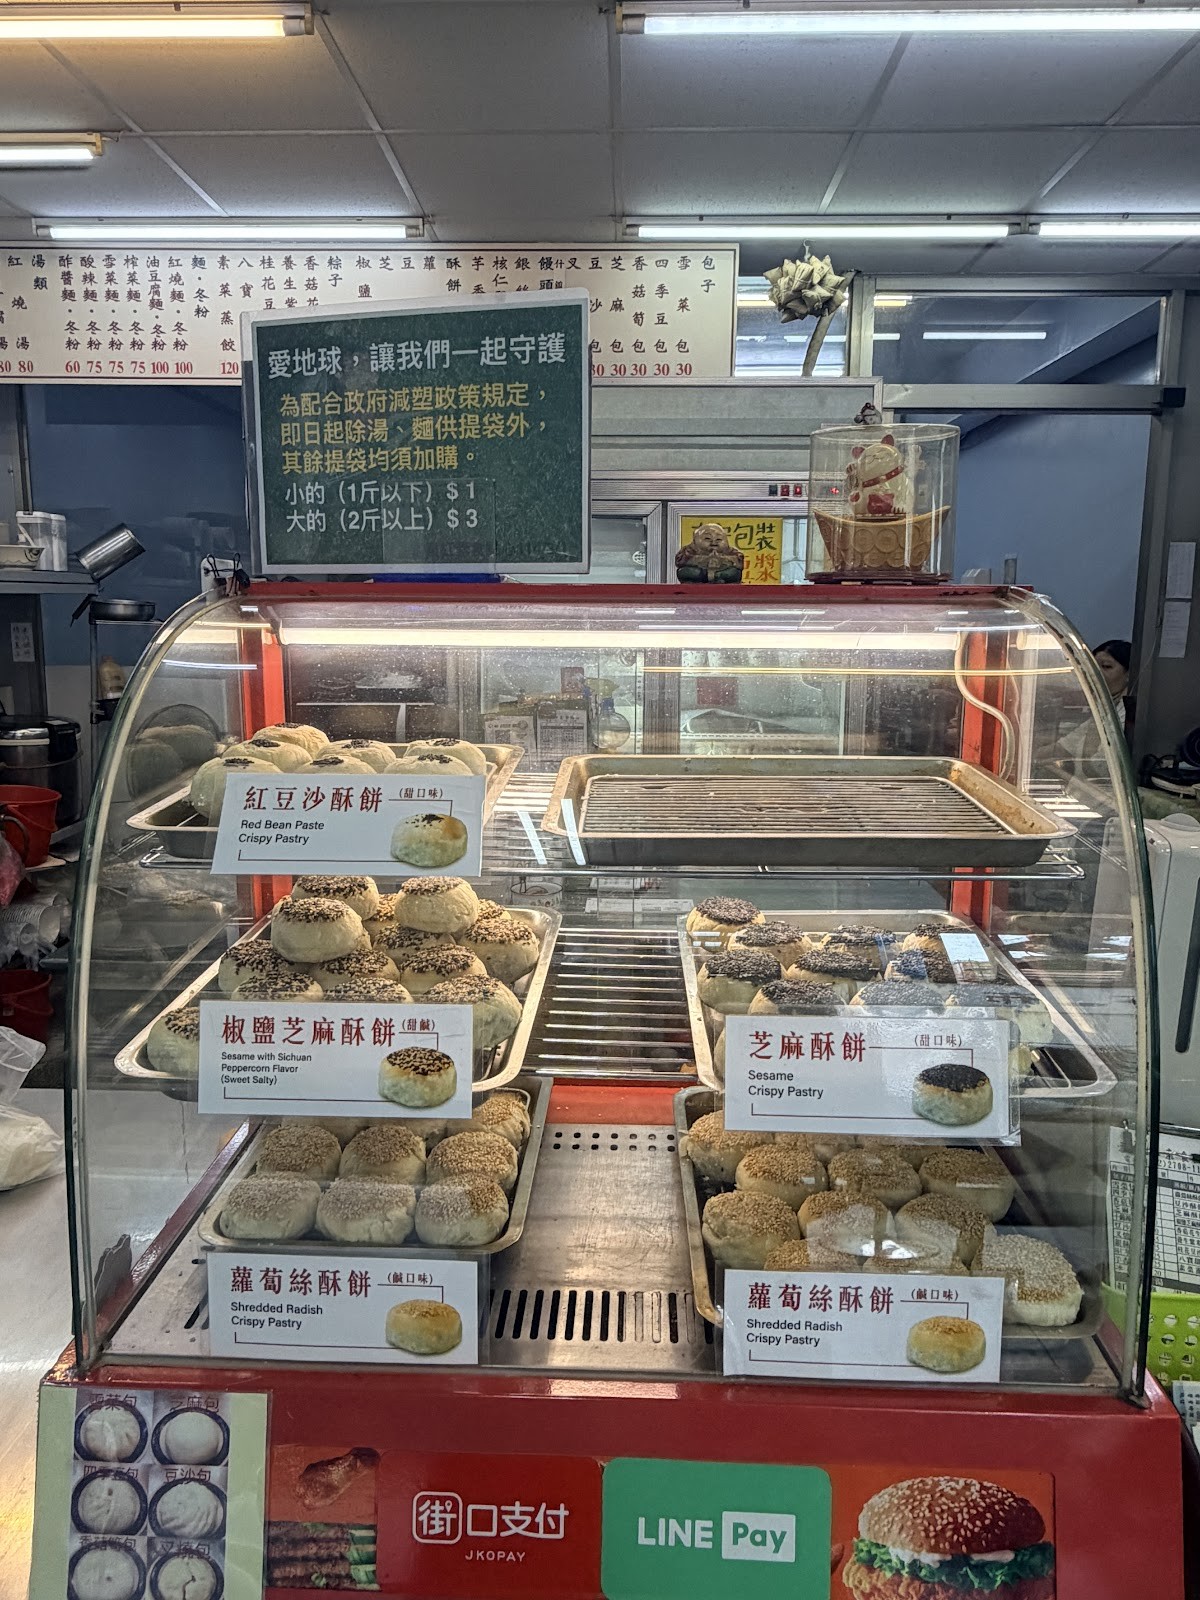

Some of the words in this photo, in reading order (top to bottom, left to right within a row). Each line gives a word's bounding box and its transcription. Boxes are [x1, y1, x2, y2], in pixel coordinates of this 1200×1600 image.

[378, 256, 394, 271] 芝
[400, 257, 416, 271] 豆
[326, 256, 343, 287] 粽子
[446, 256, 462, 293] 酥餅
[700, 256, 716, 292] 包子
[609, 256, 626, 354] 芝麻包
[654, 256, 670, 354] 四季豆包
[676, 256, 692, 354] 雪菜包
[18, 361, 33, 373] 80
[65, 361, 80, 374] 60
[87, 361, 102, 374] 75
[108, 361, 124, 374] 75
[130, 361, 146, 374] 75
[152, 361, 169, 374] 100
[175, 361, 193, 374] 100
[221, 362, 239, 375] 120
[610, 364, 627, 377] 30
[630, 364, 647, 377] 30
[654, 364, 670, 377] 30
[676, 364, 692, 377] 30
[243, 785, 383, 813] 紅豆沙酥餅
[240, 820, 263, 830] Red
[264, 820, 292, 830] Bean
[295, 820, 325, 830] Paste
[238, 833, 273, 845] Crispy
[275, 834, 310, 846] Pastry
[222, 1015, 396, 1047] 椒鹽芝麻酥餅
[748, 1030, 866, 1063] 芝麻酥餅
[221, 1052, 255, 1061] Sesame
[257, 1052, 276, 1062] with
[277, 1052, 312, 1062] Sichuan
[221, 1064, 271, 1074] Peppercorn
[272, 1064, 299, 1073] Flavor
[220, 1074, 251, 1085] (Sweet
[252, 1075, 278, 1086] Salty)
[748, 1070, 794, 1082] Sesame
[748, 1085, 785, 1098] Crispy
[787, 1086, 824, 1100] Pastry
[230, 1266, 372, 1298] 蘿蔔絲酥餅
[748, 1282, 894, 1314] 蘿蔔絲酥餅
[230, 1302, 284, 1314] Shredded
[286, 1304, 324, 1315] Radish
[231, 1315, 266, 1328] Crispy
[268, 1317, 302, 1330] Pastry
[746, 1318, 801, 1331] Shredded
[804, 1320, 843, 1332] Radish
[746, 1333, 782, 1346] Crispy
[784, 1334, 821, 1348] Pastry
[418, 1500, 570, 1542] 街口支付
[638, 1517, 714, 1549] LINE
[732, 1522, 788, 1554] Pay
[465, 1550, 526, 1562] JKOPAY
